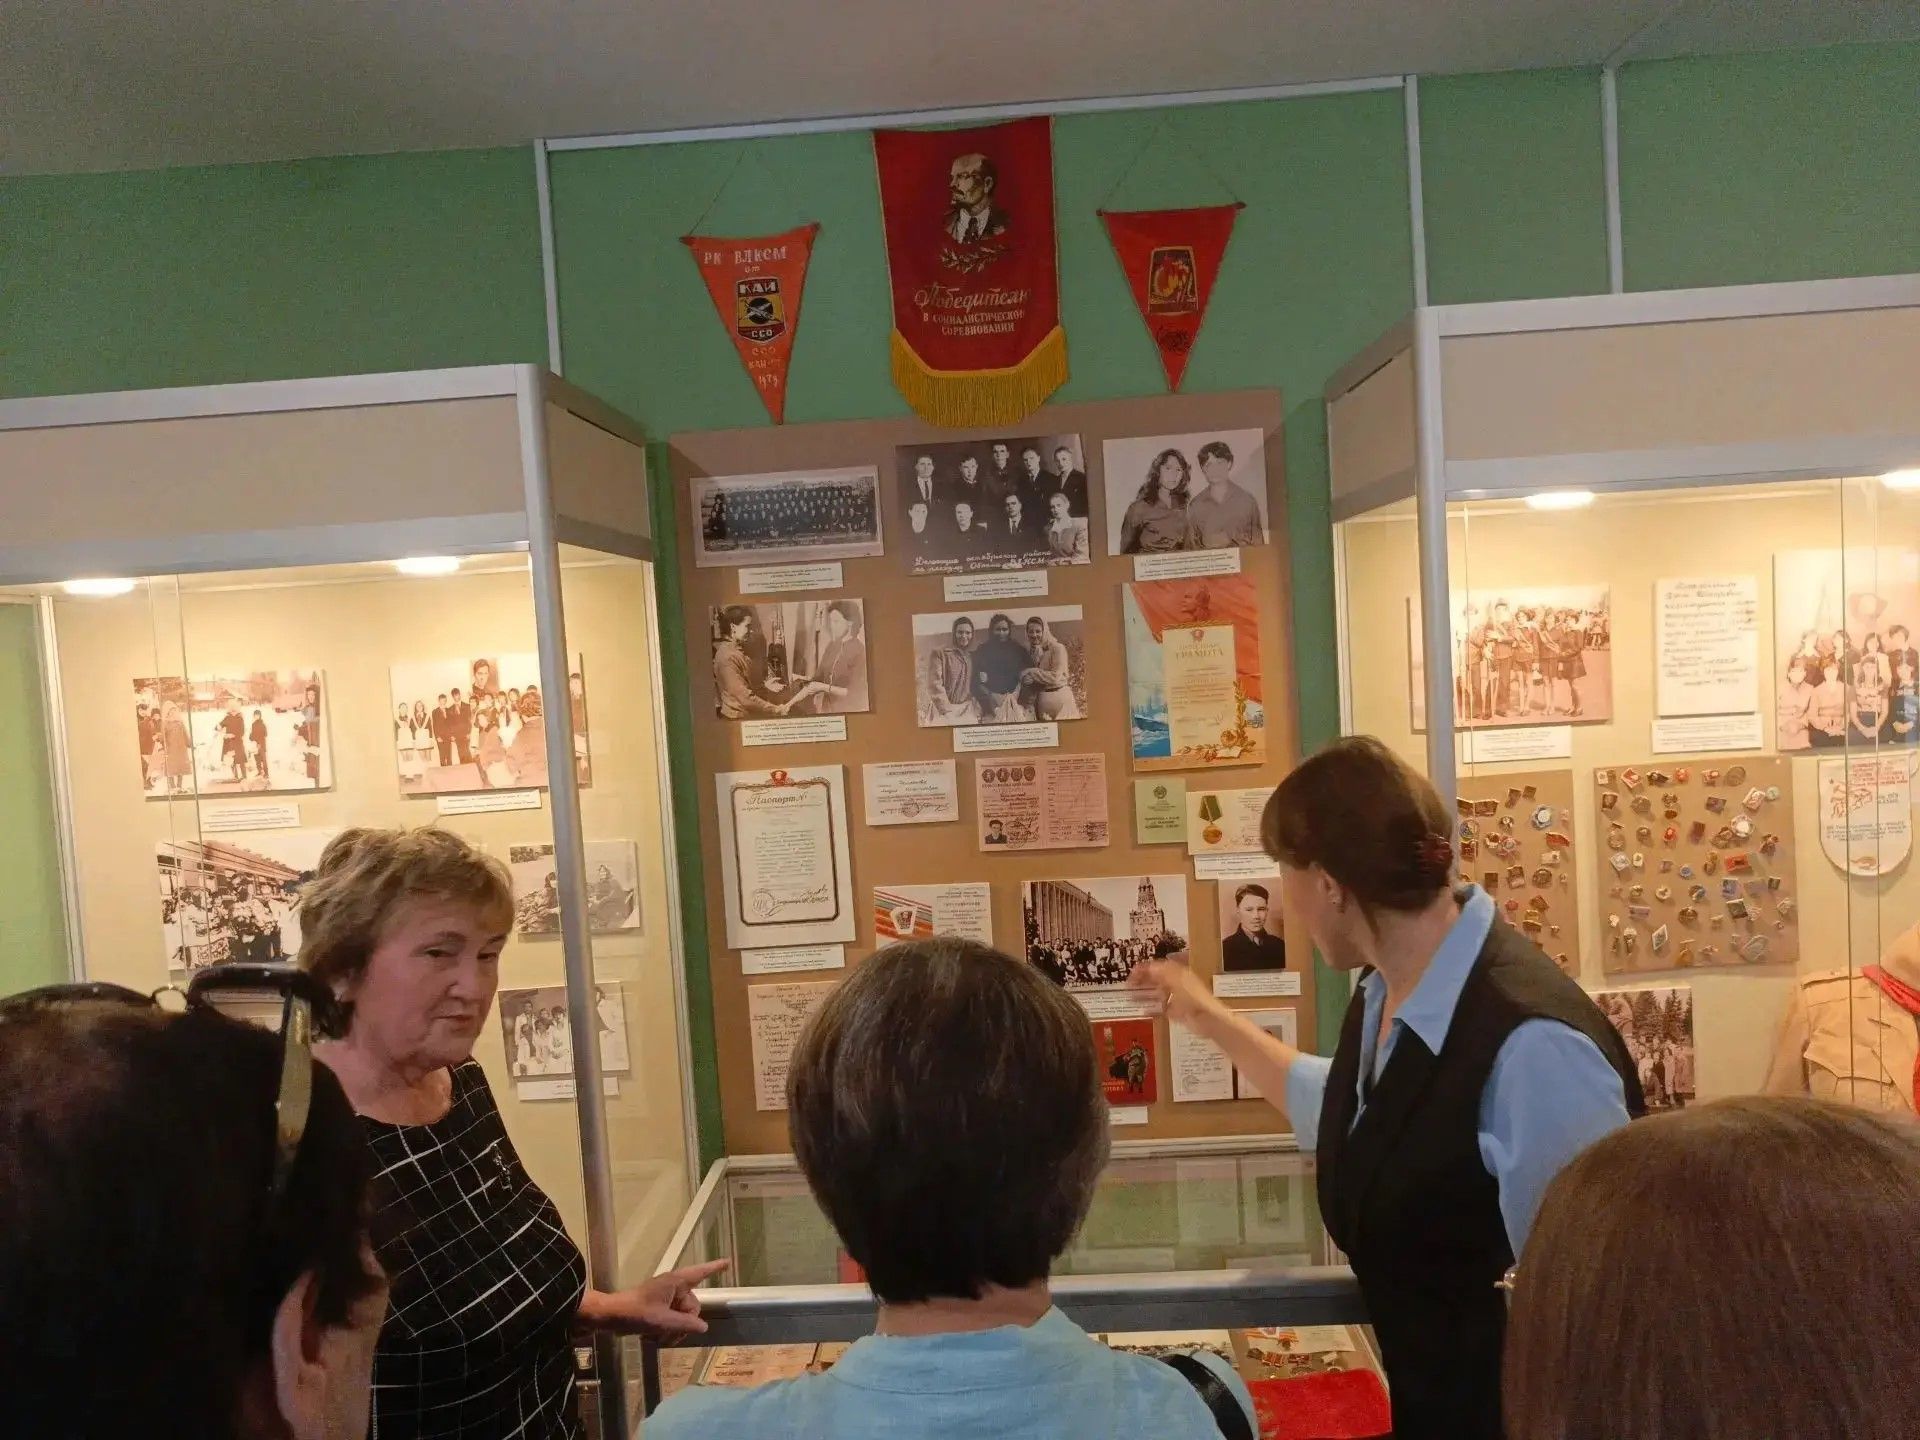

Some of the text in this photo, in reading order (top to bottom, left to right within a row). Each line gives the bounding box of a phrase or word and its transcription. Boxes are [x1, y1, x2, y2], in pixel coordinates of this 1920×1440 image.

[704, 246, 787, 265] РК ВЛКСМ
[739, 281, 778, 294] КАИ
[923, 312, 929, 322] В
[751, 329, 773, 339] ССО
[941, 322, 1015, 336] СОРЕВНОВАНИИ
